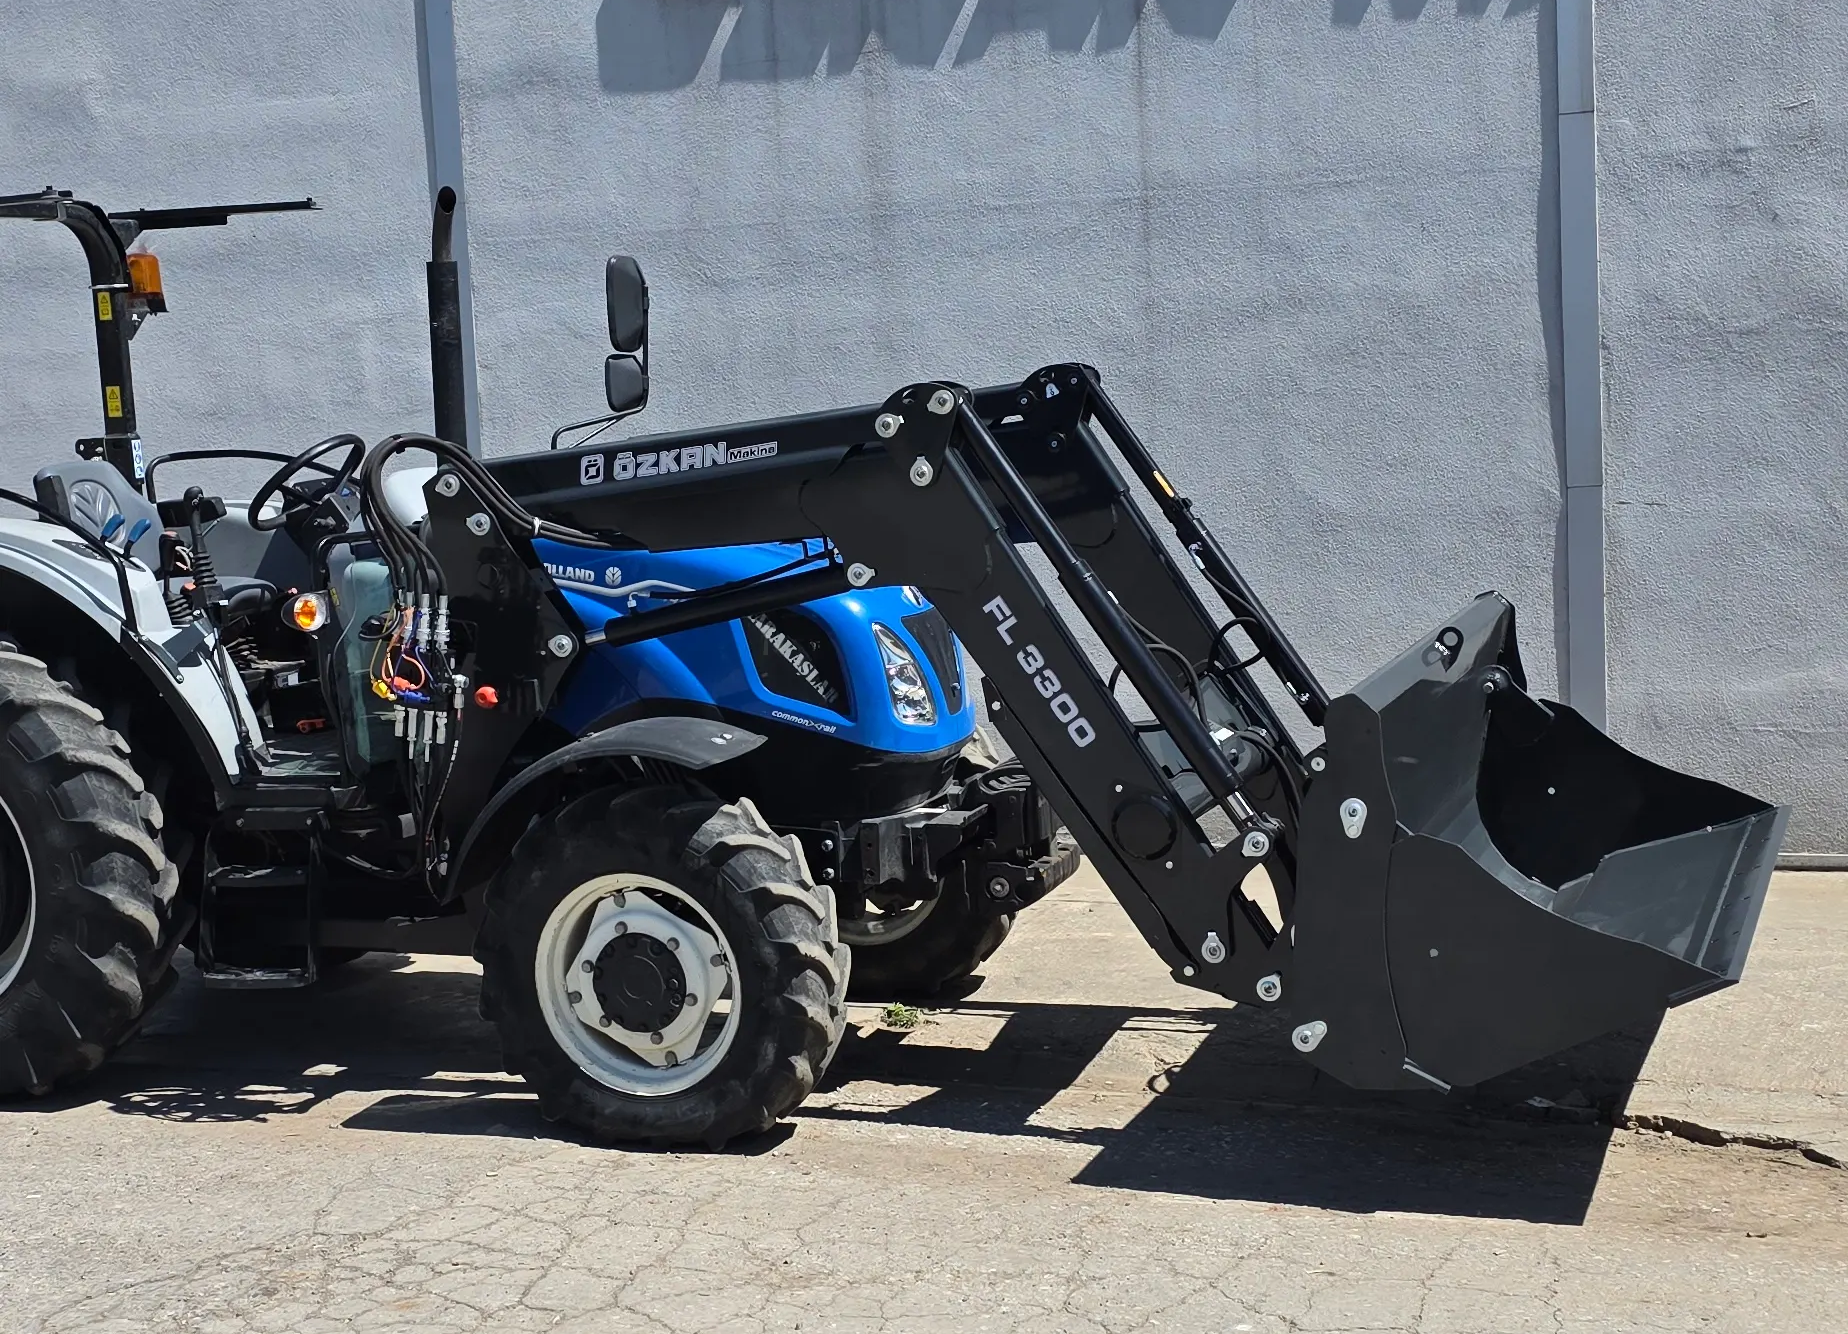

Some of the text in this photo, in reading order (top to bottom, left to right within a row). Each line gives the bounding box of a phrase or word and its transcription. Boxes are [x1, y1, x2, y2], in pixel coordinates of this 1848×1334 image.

[613, 442, 727, 481] ÖZKAN
[748, 613, 839, 704] ARAKAŞLAR
[982, 595, 1096, 748] FL 3300
